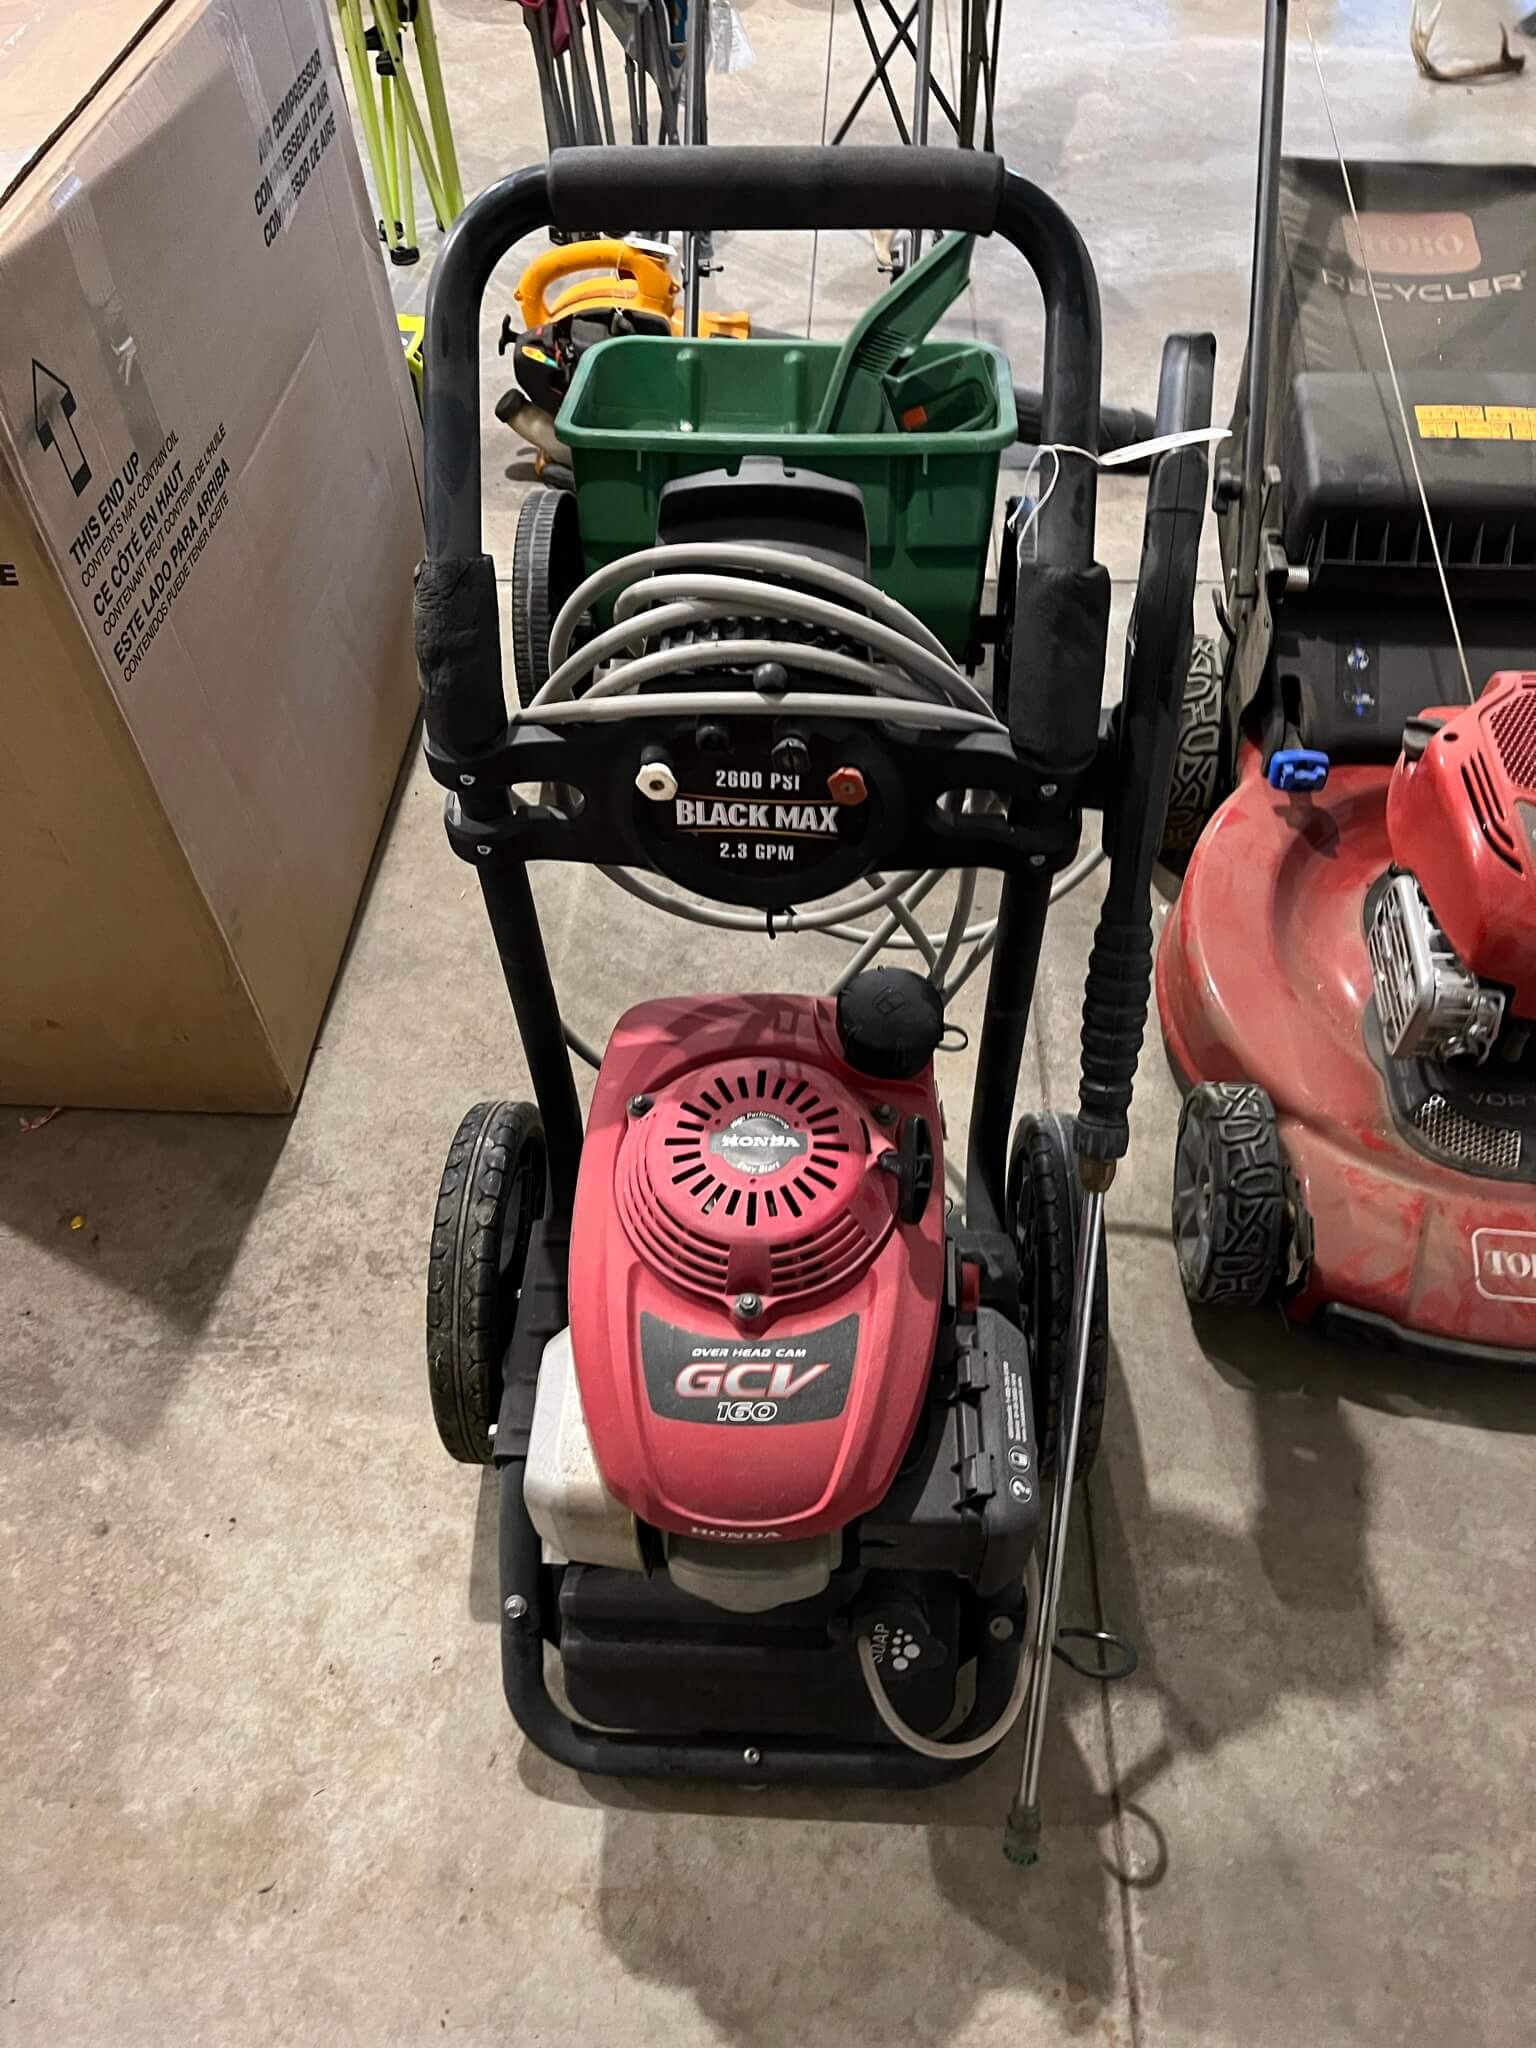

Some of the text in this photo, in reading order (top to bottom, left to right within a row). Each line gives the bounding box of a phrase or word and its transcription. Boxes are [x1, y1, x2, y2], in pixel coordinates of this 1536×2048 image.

[272, 48, 322, 139] COMPRESSOR
[309, 80, 329, 125] D'AIR
[310, 138, 321, 170] DE
[320, 110, 337, 154] AIRE
[1321, 268, 1524, 302] RECYCLER
[69, 451, 139, 565] THIS END UP
[81, 430, 179, 588] CONTENTS MAY CONTAIN OIL
[93, 460, 184, 616] CE CÔTÉ EN HAUT
[103, 422, 226, 636] CONTENANT PEUT CONTENIR DE L'HUILE
[0, 564, 19, 586] E
[113, 457, 230, 666] ESTE LADO PARA ARRIBA
[123, 490, 229, 682] CONTENIDOS PUEDE TENER ACEITE
[715, 769, 801, 792] 2600 PSI
[675, 799, 840, 834] BLACK MAX
[719, 842, 795, 862] 2.3 GPM
[721, 1133, 801, 1148] HONDA
[1484, 1249, 1536, 1280] TO
[691, 1347, 808, 1359] OVER HEAD CAM
[675, 1361, 832, 1400] GCV
[716, 1401, 779, 1423] 160
[690, 1526, 783, 1539] HONDA
